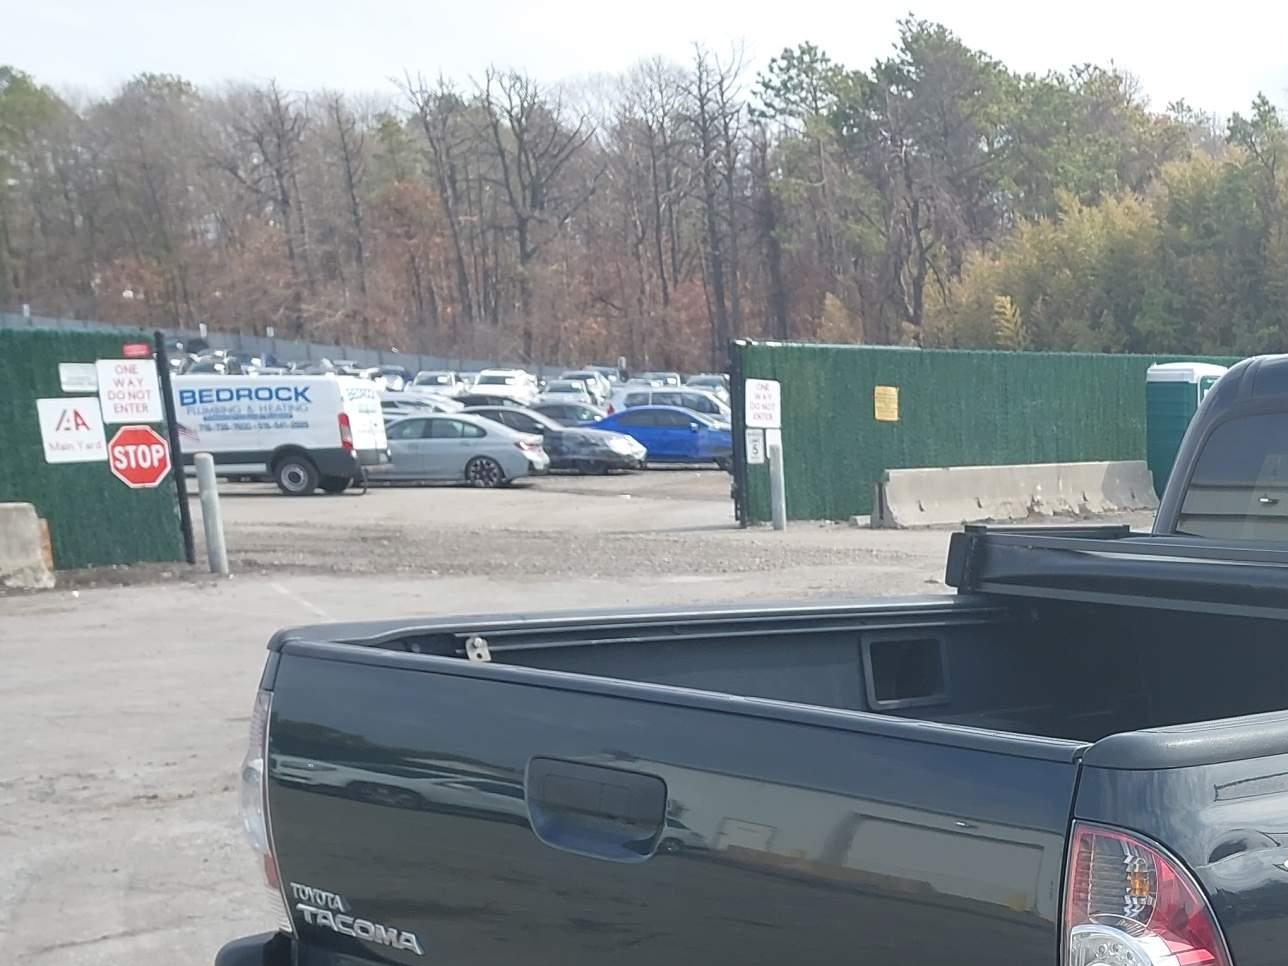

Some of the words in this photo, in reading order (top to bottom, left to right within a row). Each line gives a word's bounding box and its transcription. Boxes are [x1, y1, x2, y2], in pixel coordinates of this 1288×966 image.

[115, 364, 138, 375] ONE
[113, 379, 144, 388] WAY
[107, 390, 125, 400] DO
[128, 390, 151, 400] NOT
[178, 387, 312, 406] BEDROCK
[113, 403, 148, 413] ENTER
[113, 444, 164, 470] STOP
[290, 881, 346, 913] TOYOTA
[296, 903, 424, 956] TACOMA
